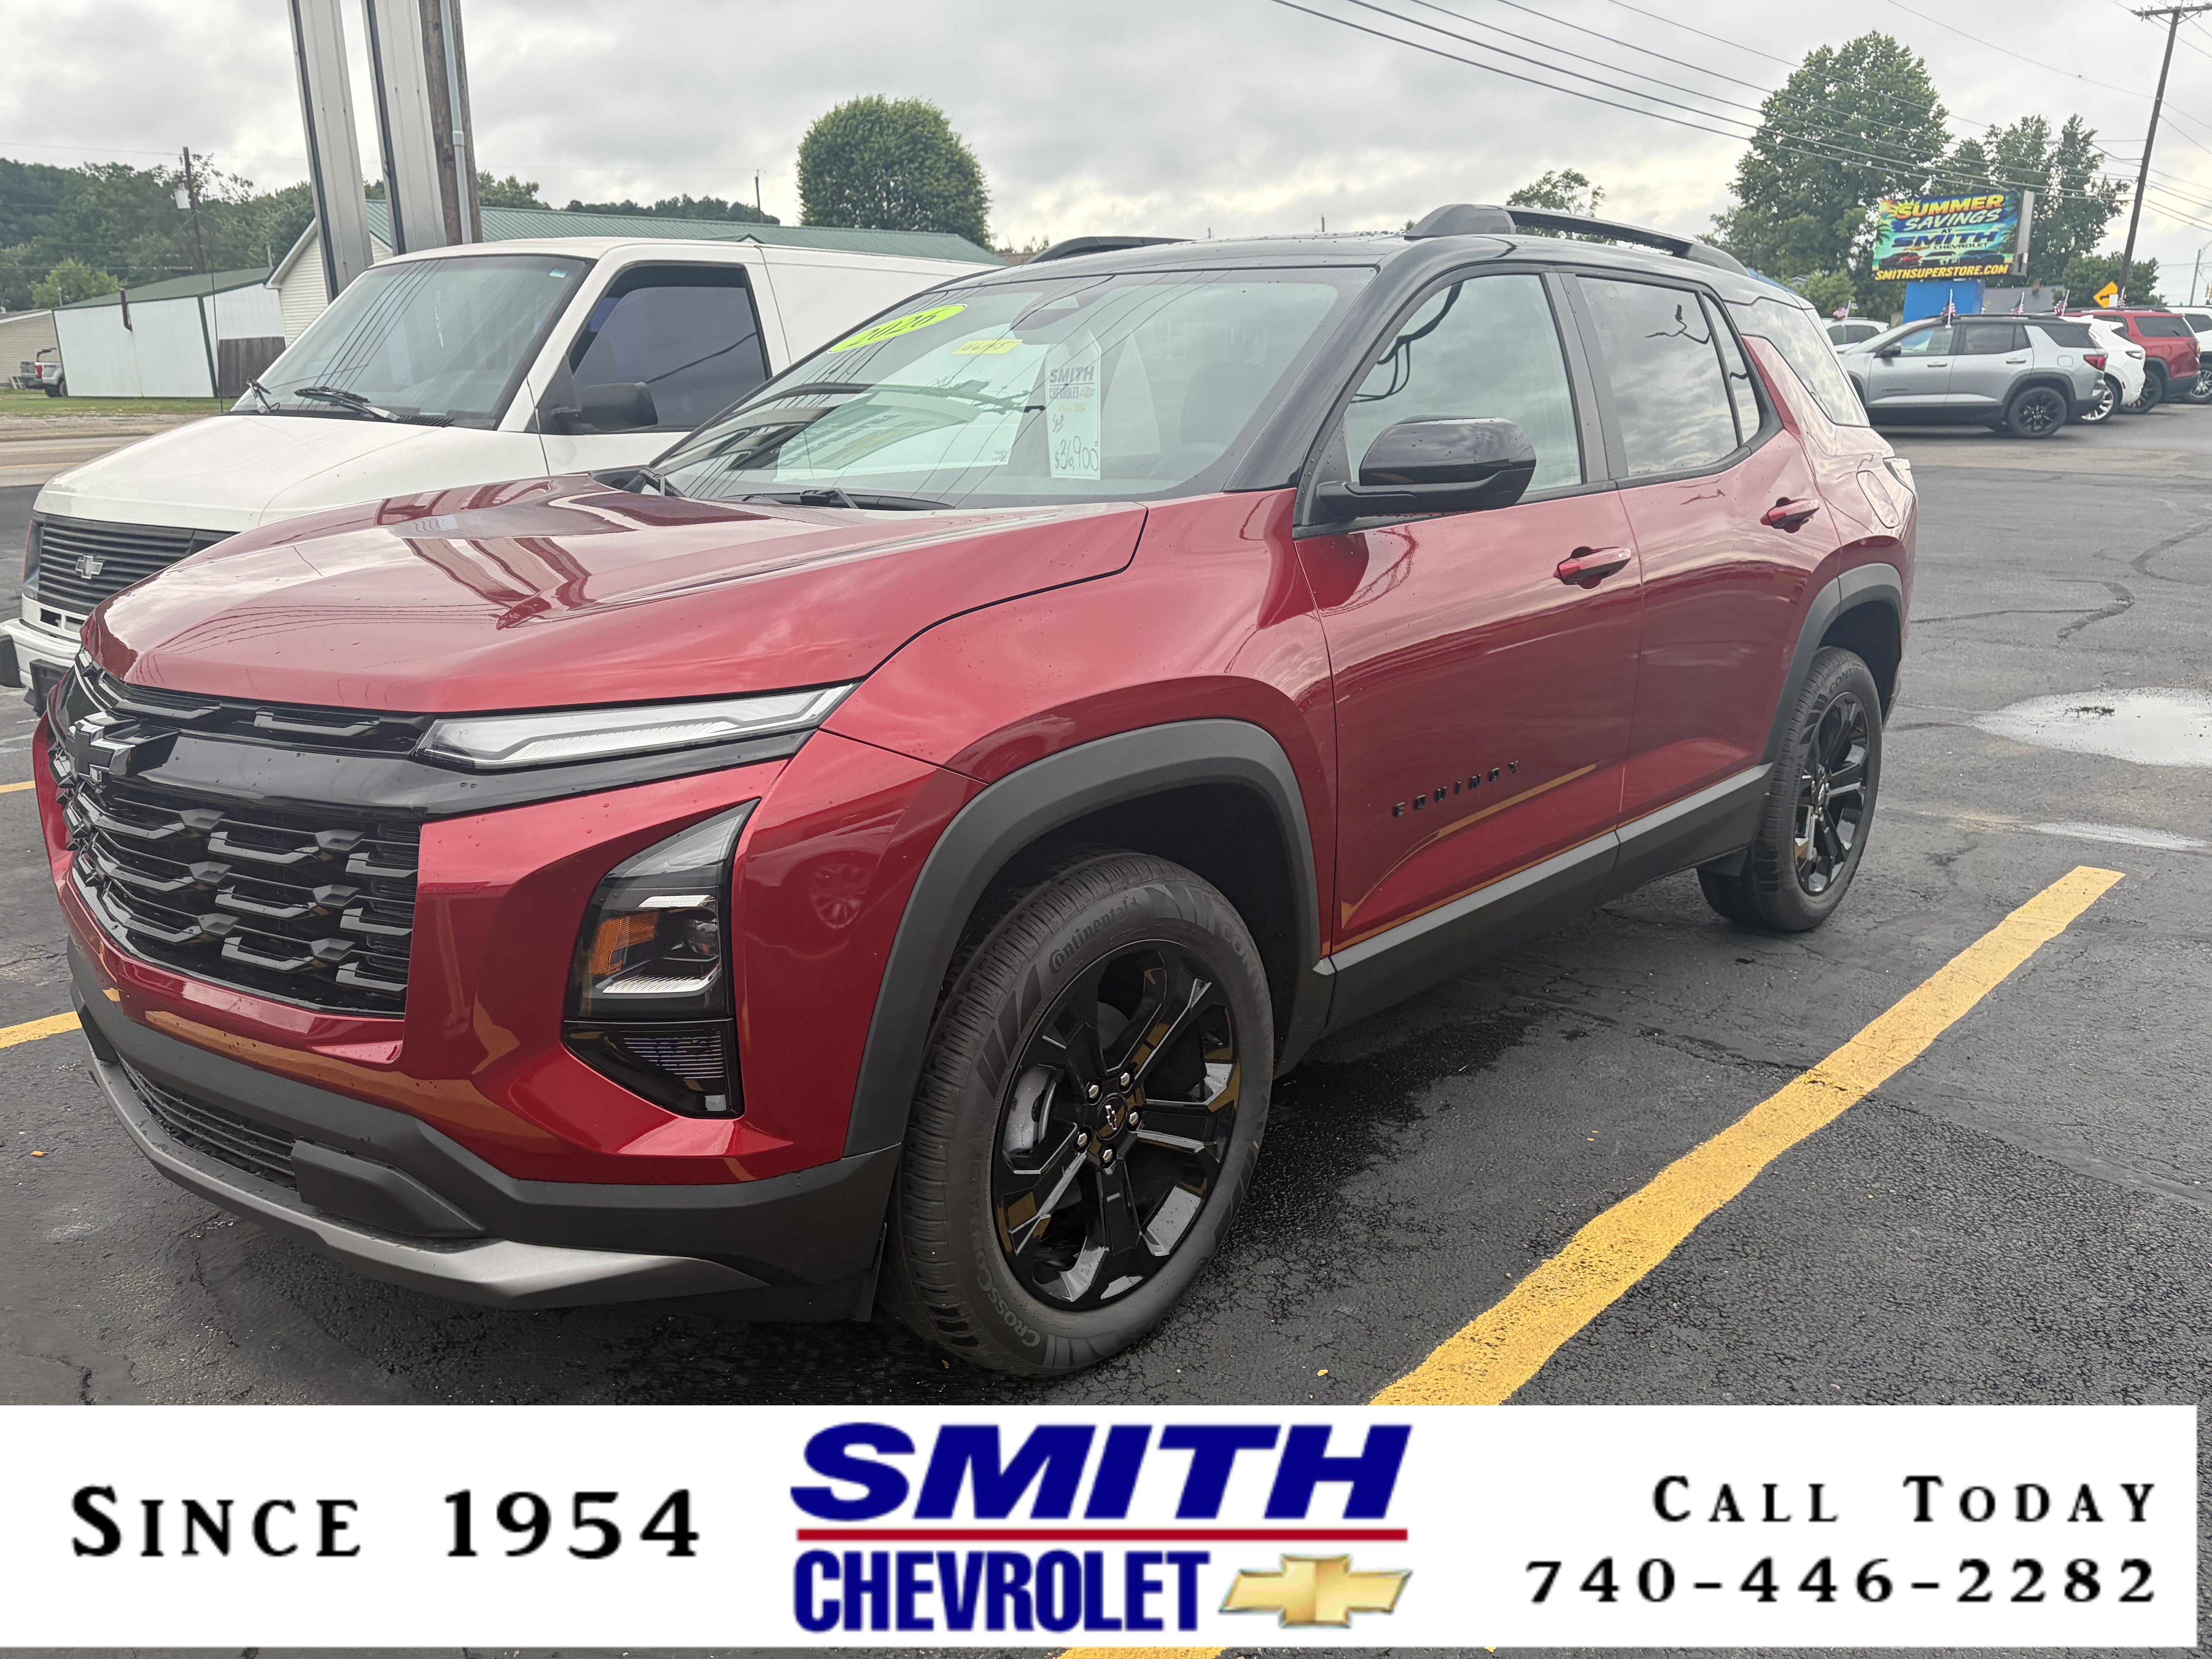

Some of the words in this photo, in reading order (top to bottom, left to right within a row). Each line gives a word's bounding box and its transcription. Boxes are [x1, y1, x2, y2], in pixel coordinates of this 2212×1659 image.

[1895, 194, 2004, 220] SUMMER
[1903, 208, 2002, 231] SAVINGS
[1892, 231, 1999, 247] SMITH
[1875, 264, 2009, 280] SMITHSUPERSTORE.COM
[1049, 366, 1095, 383] SMITH
[1049, 386, 1079, 400] CHEVROLET
[1393, 760, 1519, 817] EQUINOX
[1049, 898, 1128, 975] Continental
